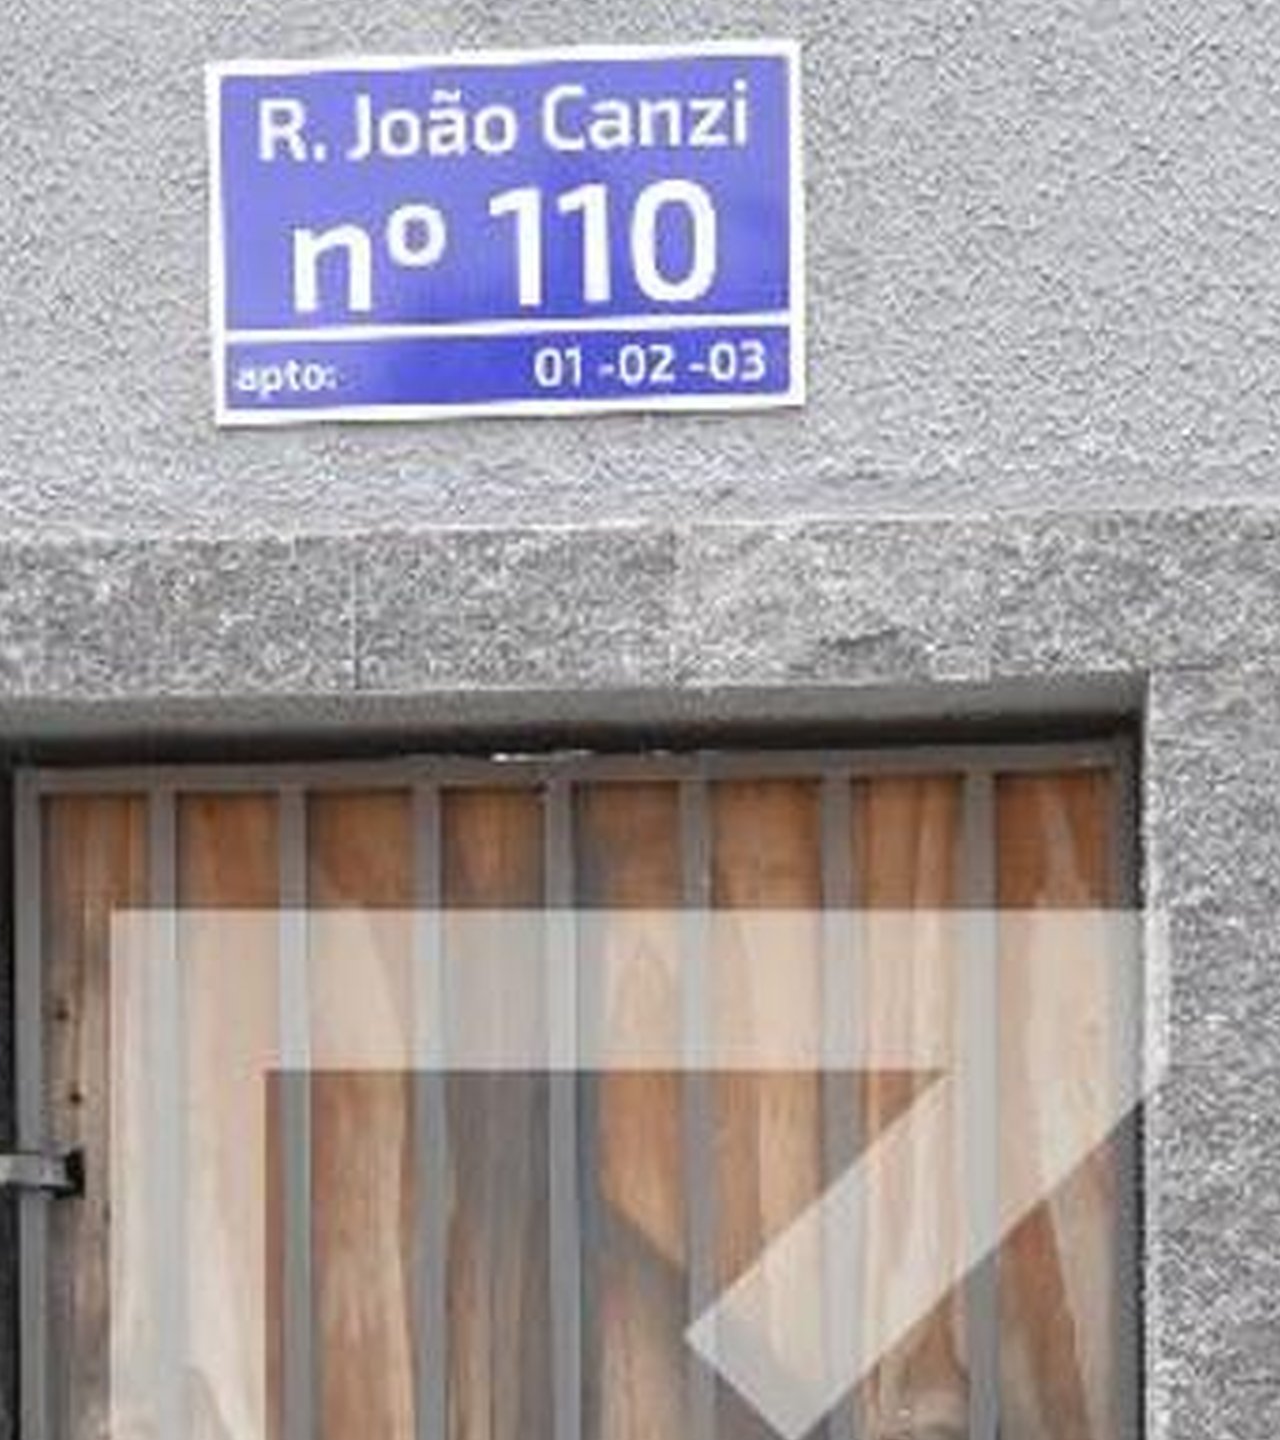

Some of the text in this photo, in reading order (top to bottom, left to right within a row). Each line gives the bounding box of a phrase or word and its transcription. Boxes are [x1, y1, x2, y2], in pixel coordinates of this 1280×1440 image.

[258, 80, 748, 160] R. João Canzi
[489, 179, 717, 306] 110
[235, 360, 338, 396] apto:
